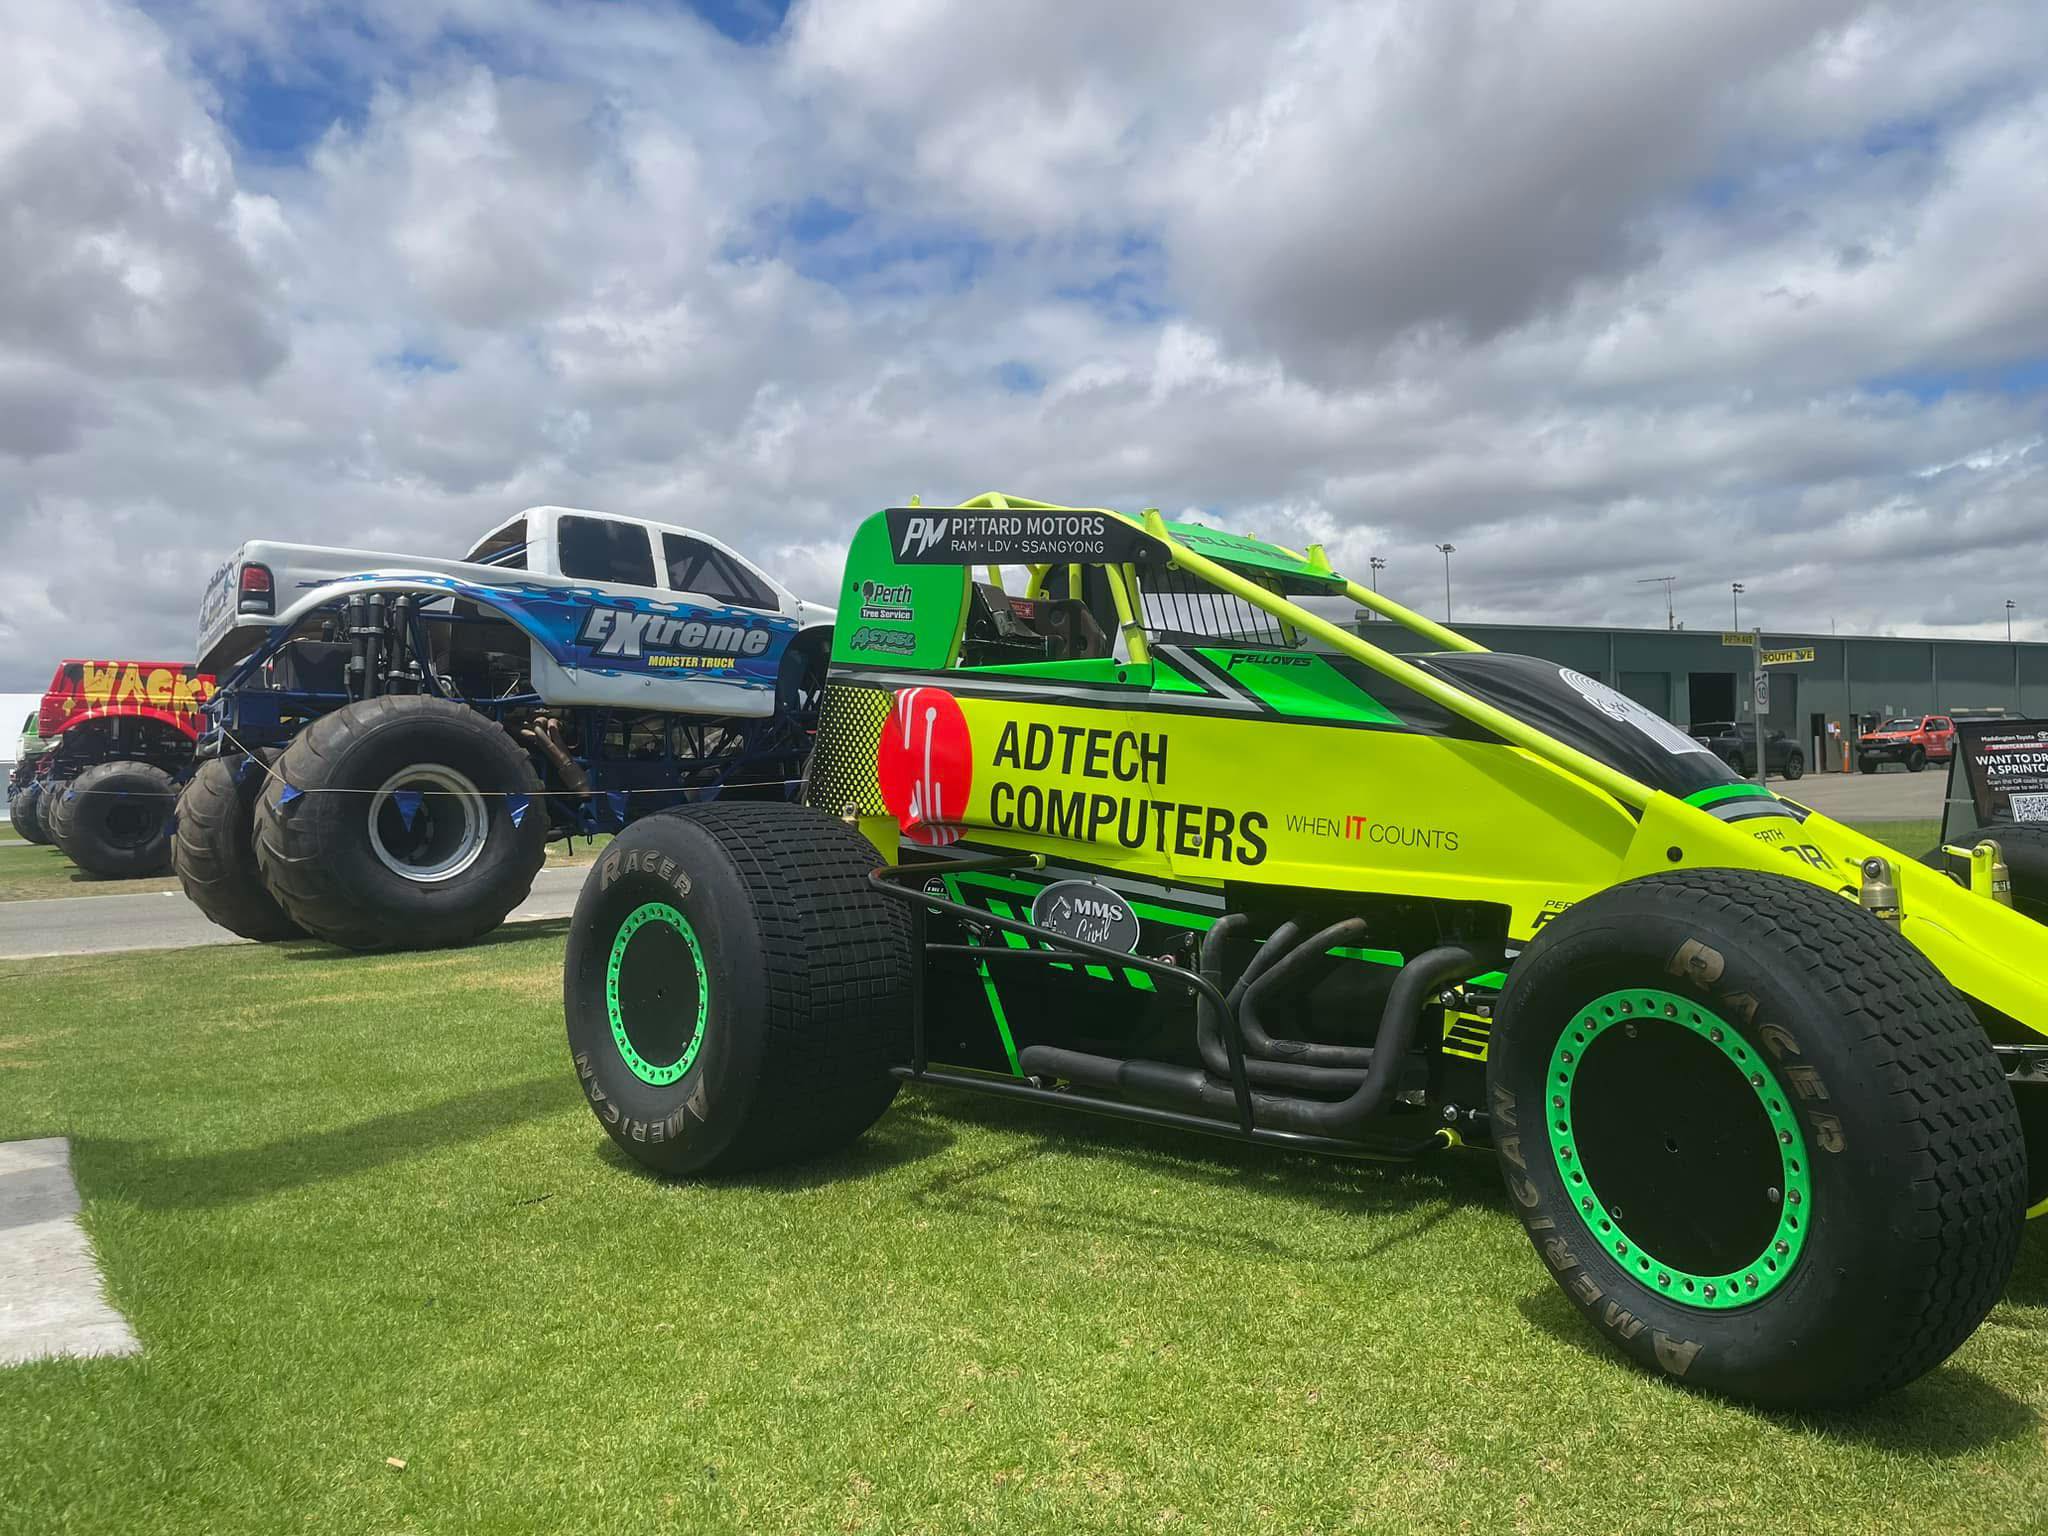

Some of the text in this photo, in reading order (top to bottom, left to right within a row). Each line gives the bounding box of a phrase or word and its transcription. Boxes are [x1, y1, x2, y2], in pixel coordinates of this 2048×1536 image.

[900, 517, 949, 557] PM
[1026, 516, 1105, 536] MOTORS
[951, 540, 1104, 554] RAM LDV SSANGYONG
[873, 584, 912, 603] Perth
[862, 609, 911, 619] Tree Service
[648, 656, 735, 669] MONSTER TRUCK
[1226, 653, 1313, 671] FELLOWES
[1762, 652, 1793, 663] SOUTH
[1758, 687, 1767, 699] 10
[992, 720, 1169, 785] ADTECH
[1976, 754, 2012, 765] WANT
[2013, 754, 2031, 763] TO
[1987, 763, 2048, 776] A SPRINTC
[990, 781, 1269, 866] COMPUTERS
[1286, 814, 1459, 851] WHEN IT COUNTS
[601, 848, 694, 898] RACER
[1074, 898, 1123, 921] MMS
[1669, 937, 1847, 1153] RACER
